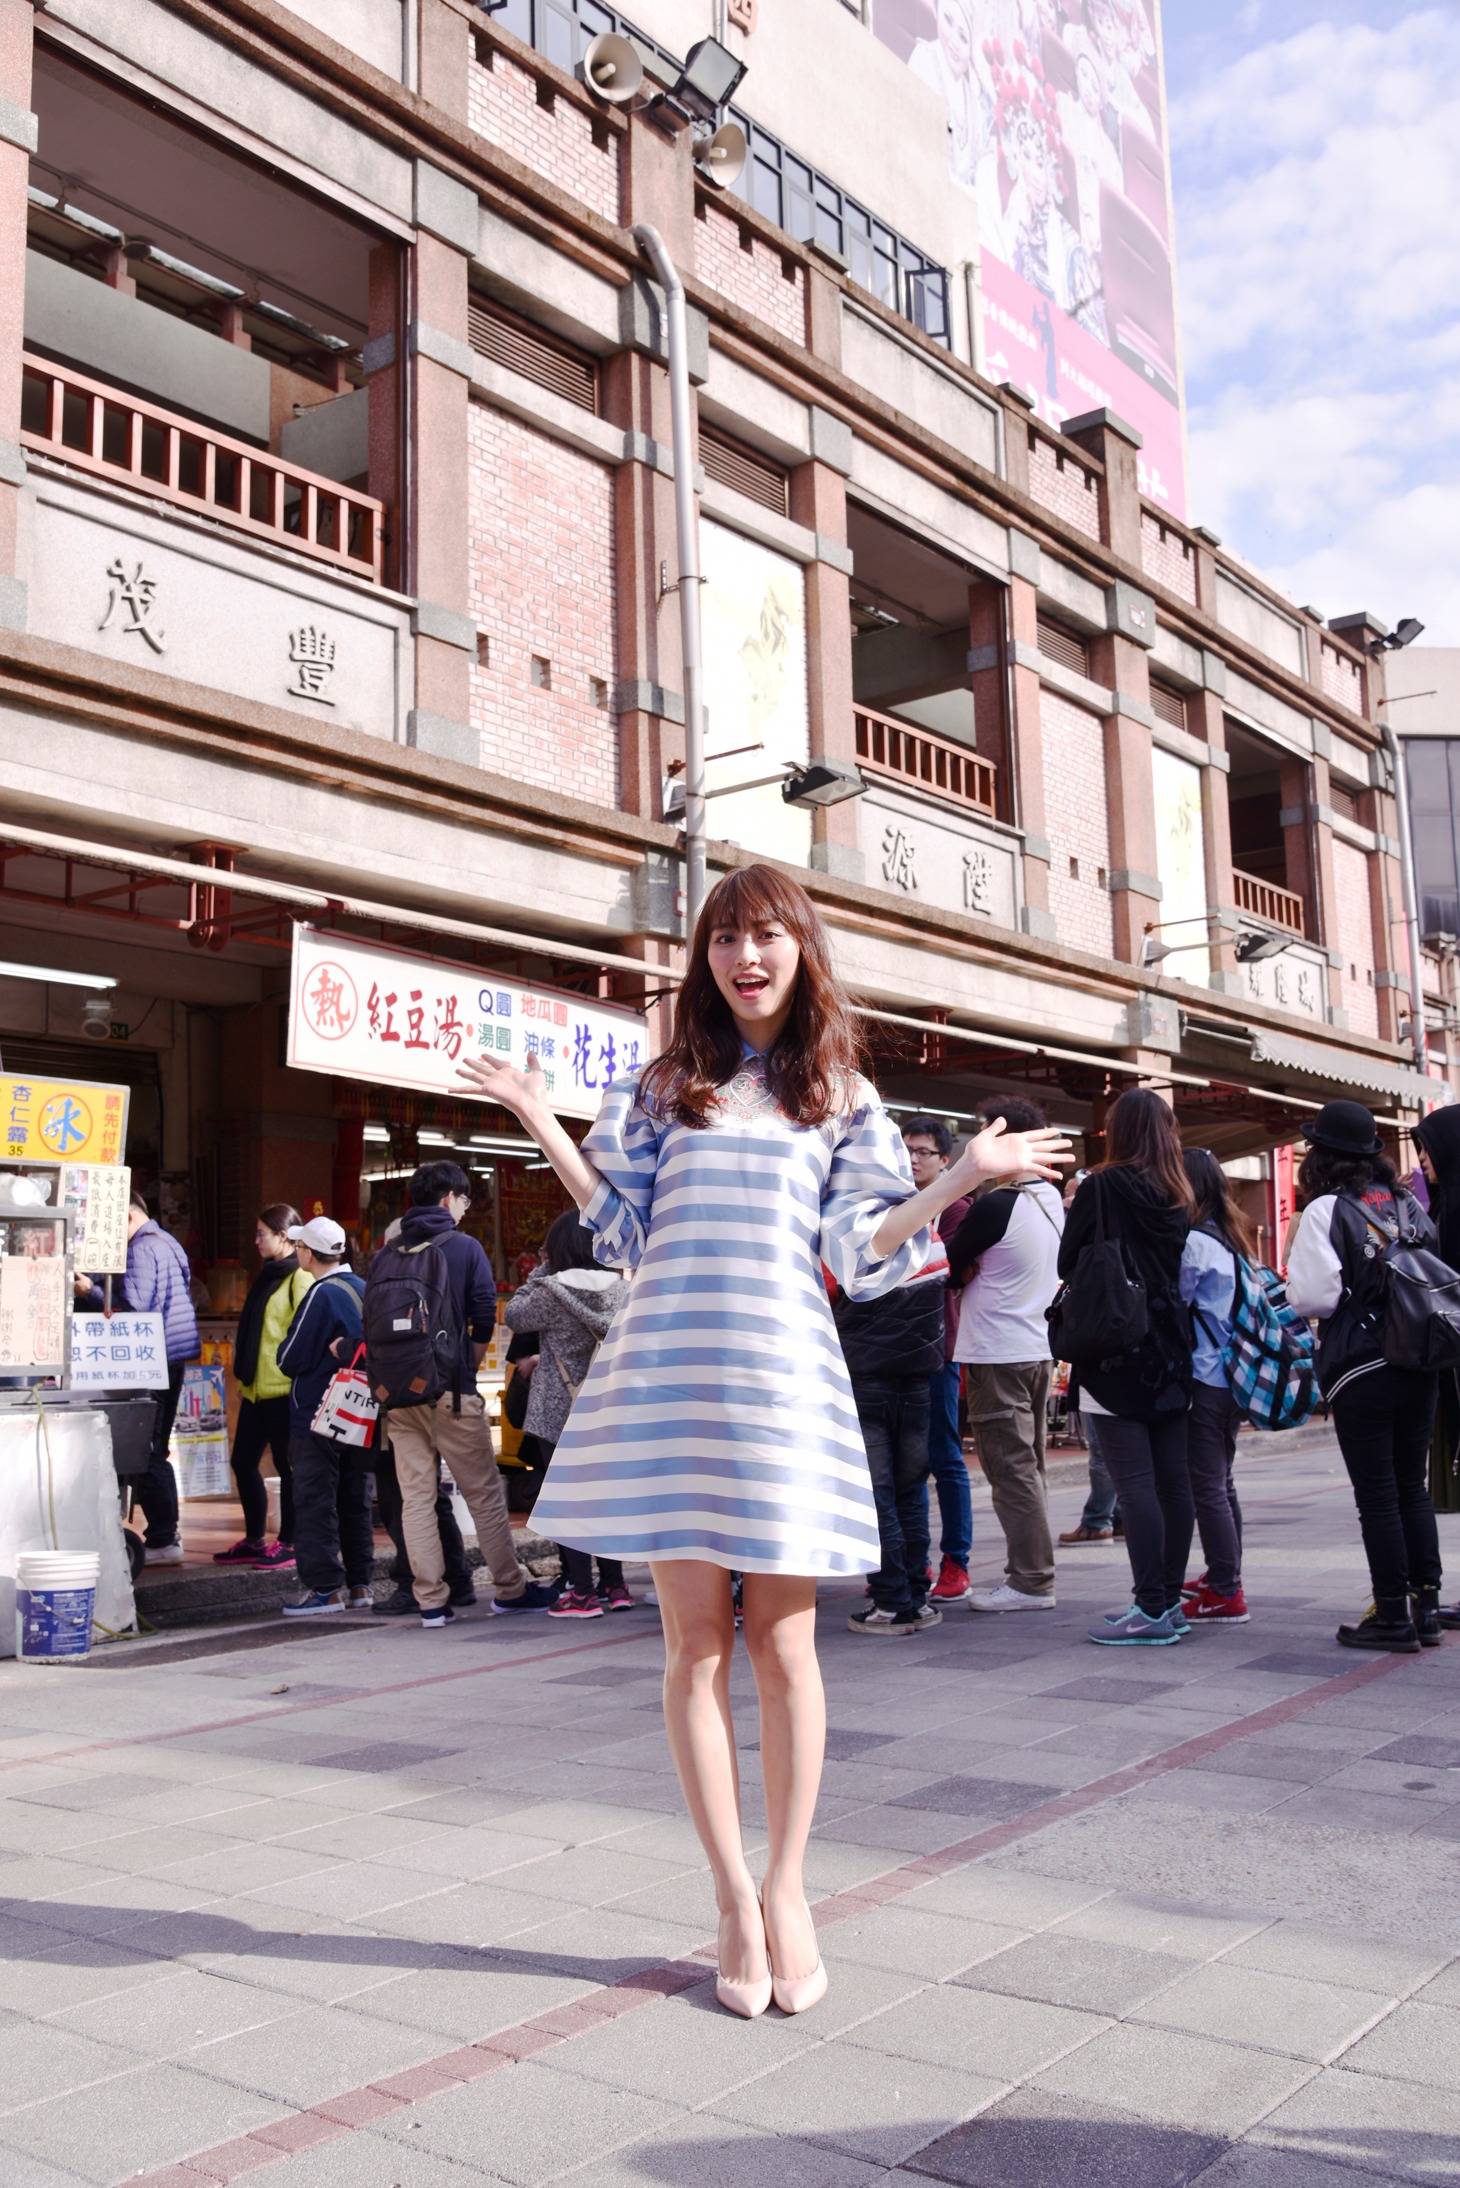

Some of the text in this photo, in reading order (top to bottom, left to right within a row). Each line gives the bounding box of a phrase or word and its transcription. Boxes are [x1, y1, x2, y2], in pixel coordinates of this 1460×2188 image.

[310, 968, 351, 1032] 熱
[478, 989, 512, 1017] Q圓
[520, 993, 568, 1027] 地瓜圓
[367, 981, 464, 1061] 紅豆湯
[477, 1022, 512, 1052] 湯圓
[524, 1030, 556, 1059] 油條
[7, 1085, 32, 1143] 杏仁露
[100, 1095, 121, 1162] 請先付款
[8, 1145, 24, 1156] 35
[70, 1370, 162, 1381] 用紙杯加5元
